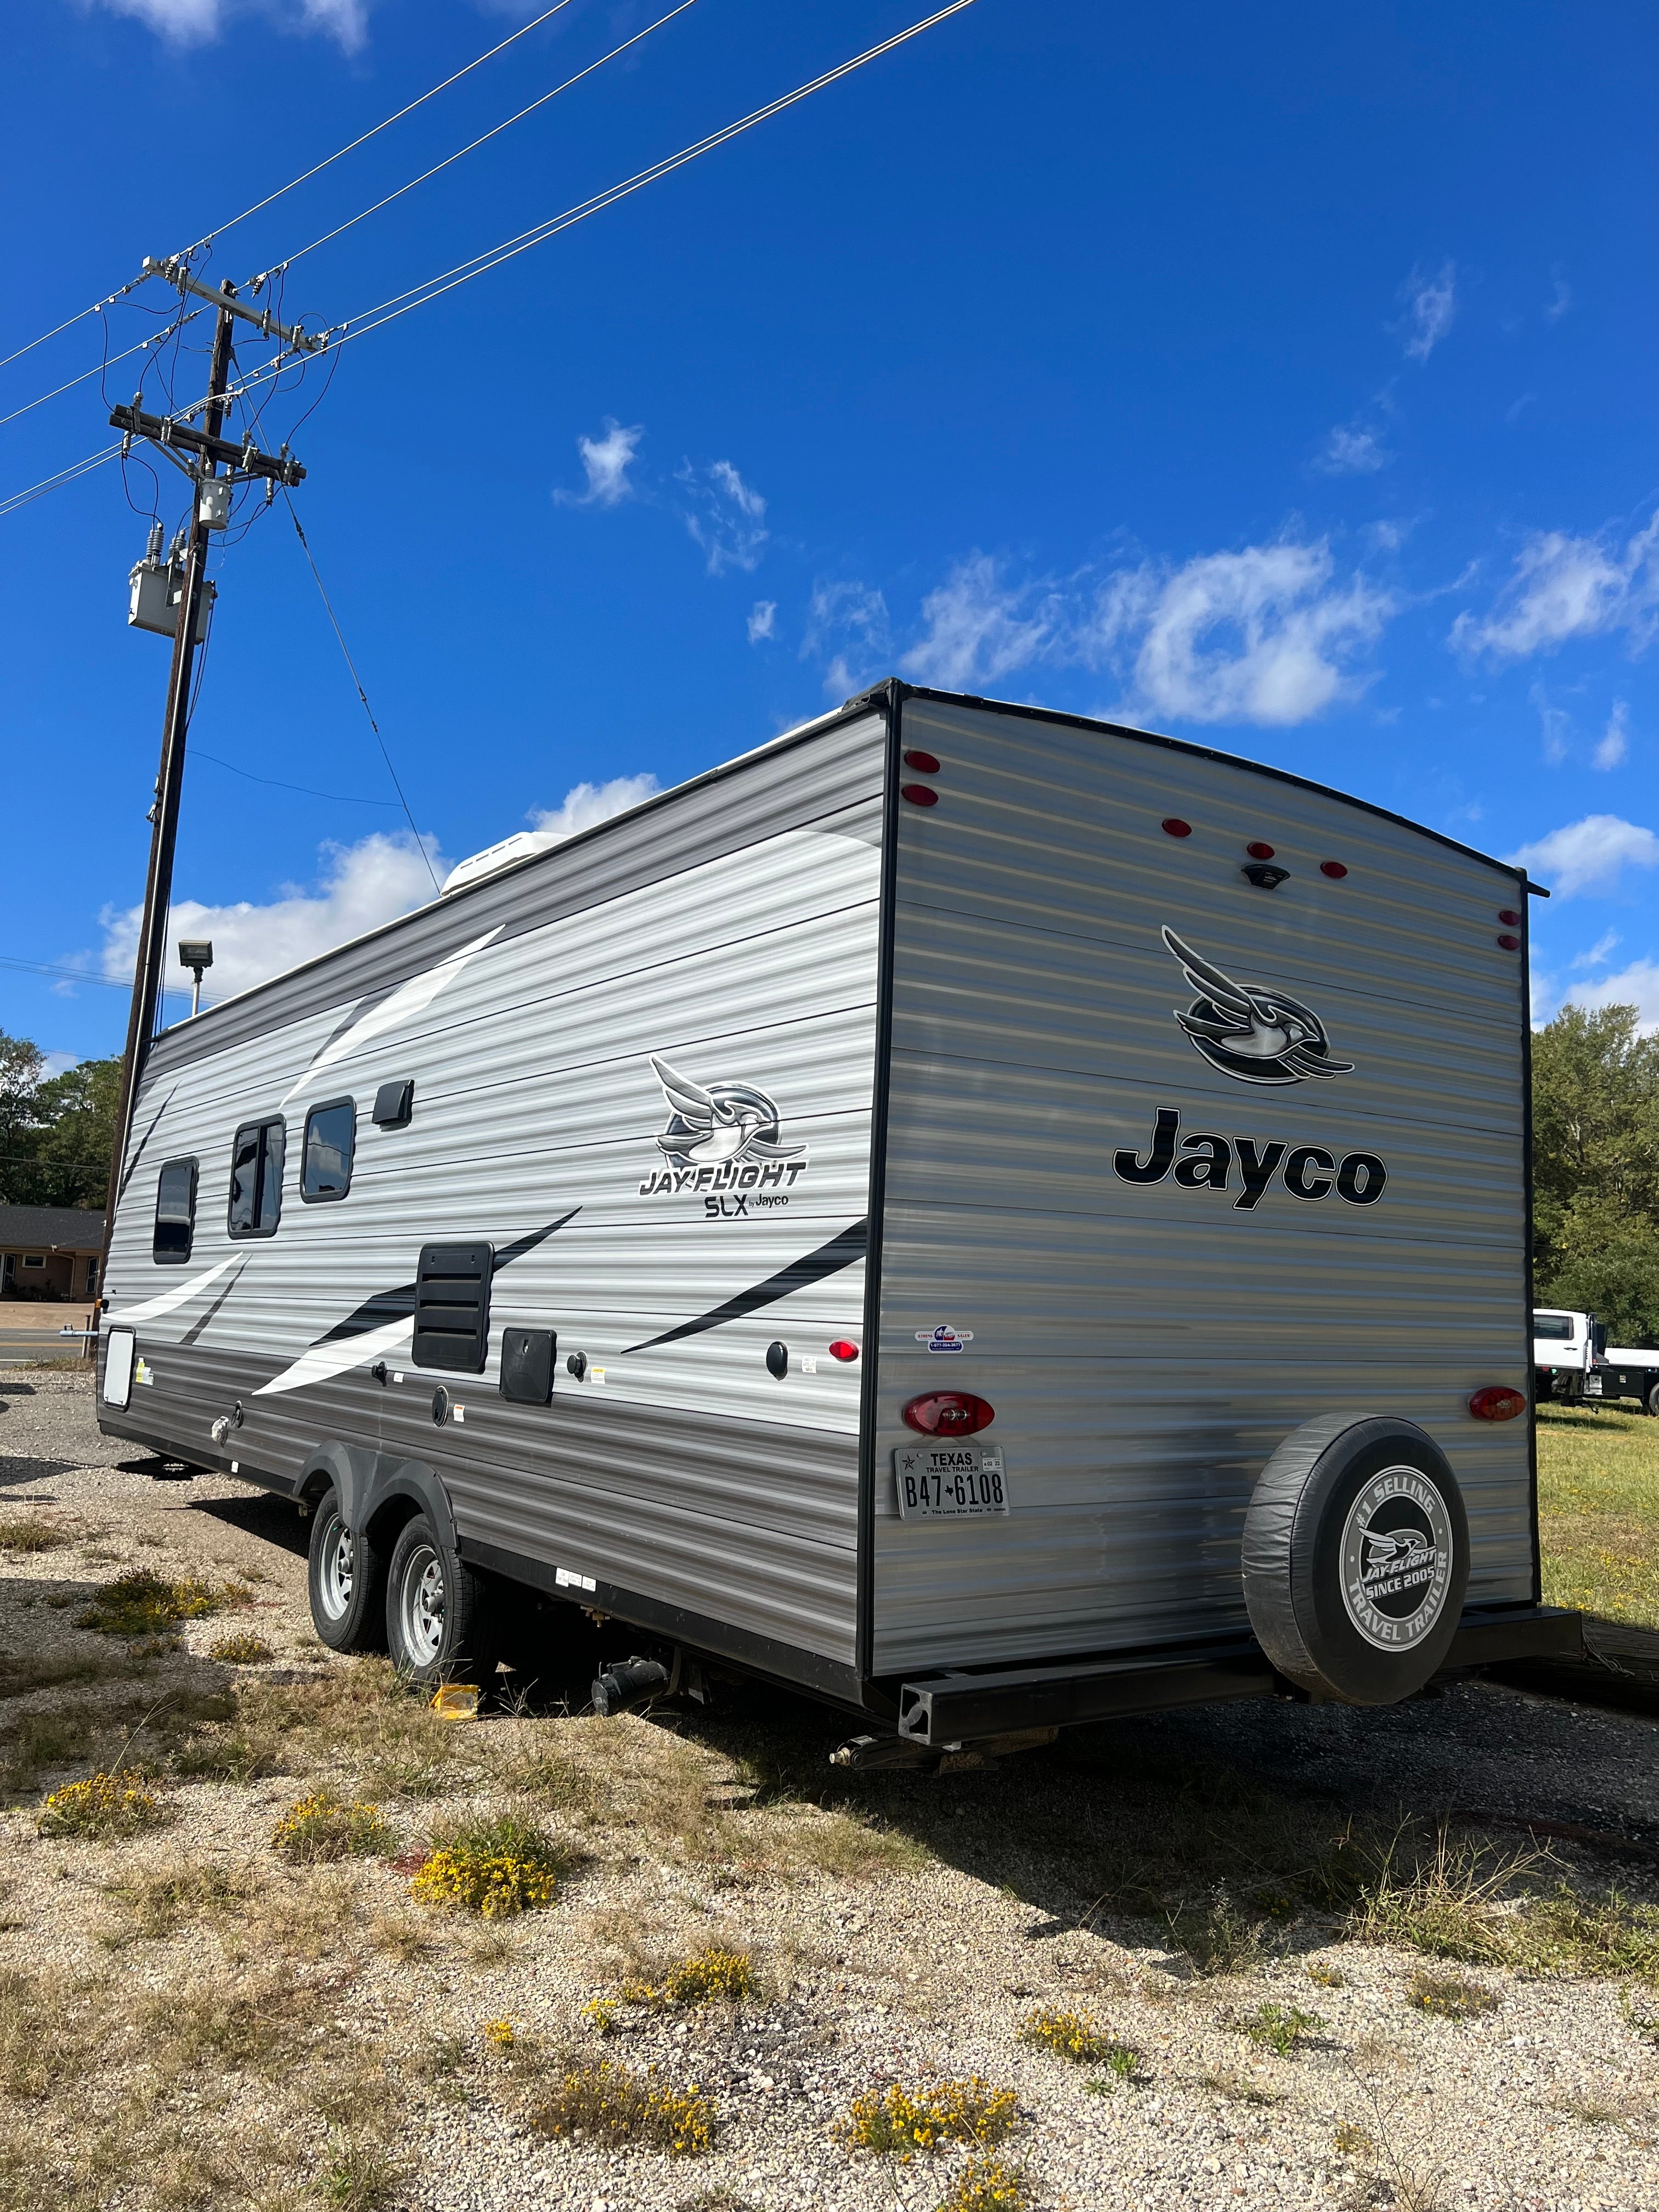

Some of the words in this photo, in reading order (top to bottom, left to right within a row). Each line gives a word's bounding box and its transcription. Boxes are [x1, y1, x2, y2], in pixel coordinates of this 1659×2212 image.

[1113, 1106, 1387, 1211] Jayco
[639, 1170, 693, 1195] JAY
[693, 1162, 806, 1191] FLIGHT
[705, 1194, 748, 1217] SLX
[755, 1193, 789, 1208] Jayco
[930, 1453, 973, 1466] TEXAS
[905, 1475, 941, 1508] B47
[954, 1474, 1003, 1505] 6108
[1355, 1501, 1373, 1527] #1
[1374, 1476, 1437, 1515] SELLING
[1362, 1565, 1390, 1583] JAY
[1390, 1549, 1436, 1573] FLIGHT
[1366, 1577, 1402, 1600] SINCE
[1403, 1565, 1435, 1587] 2005
[1350, 1577, 1401, 1641] TRAVEL
[1405, 1551, 1448, 1638] TRAILER
